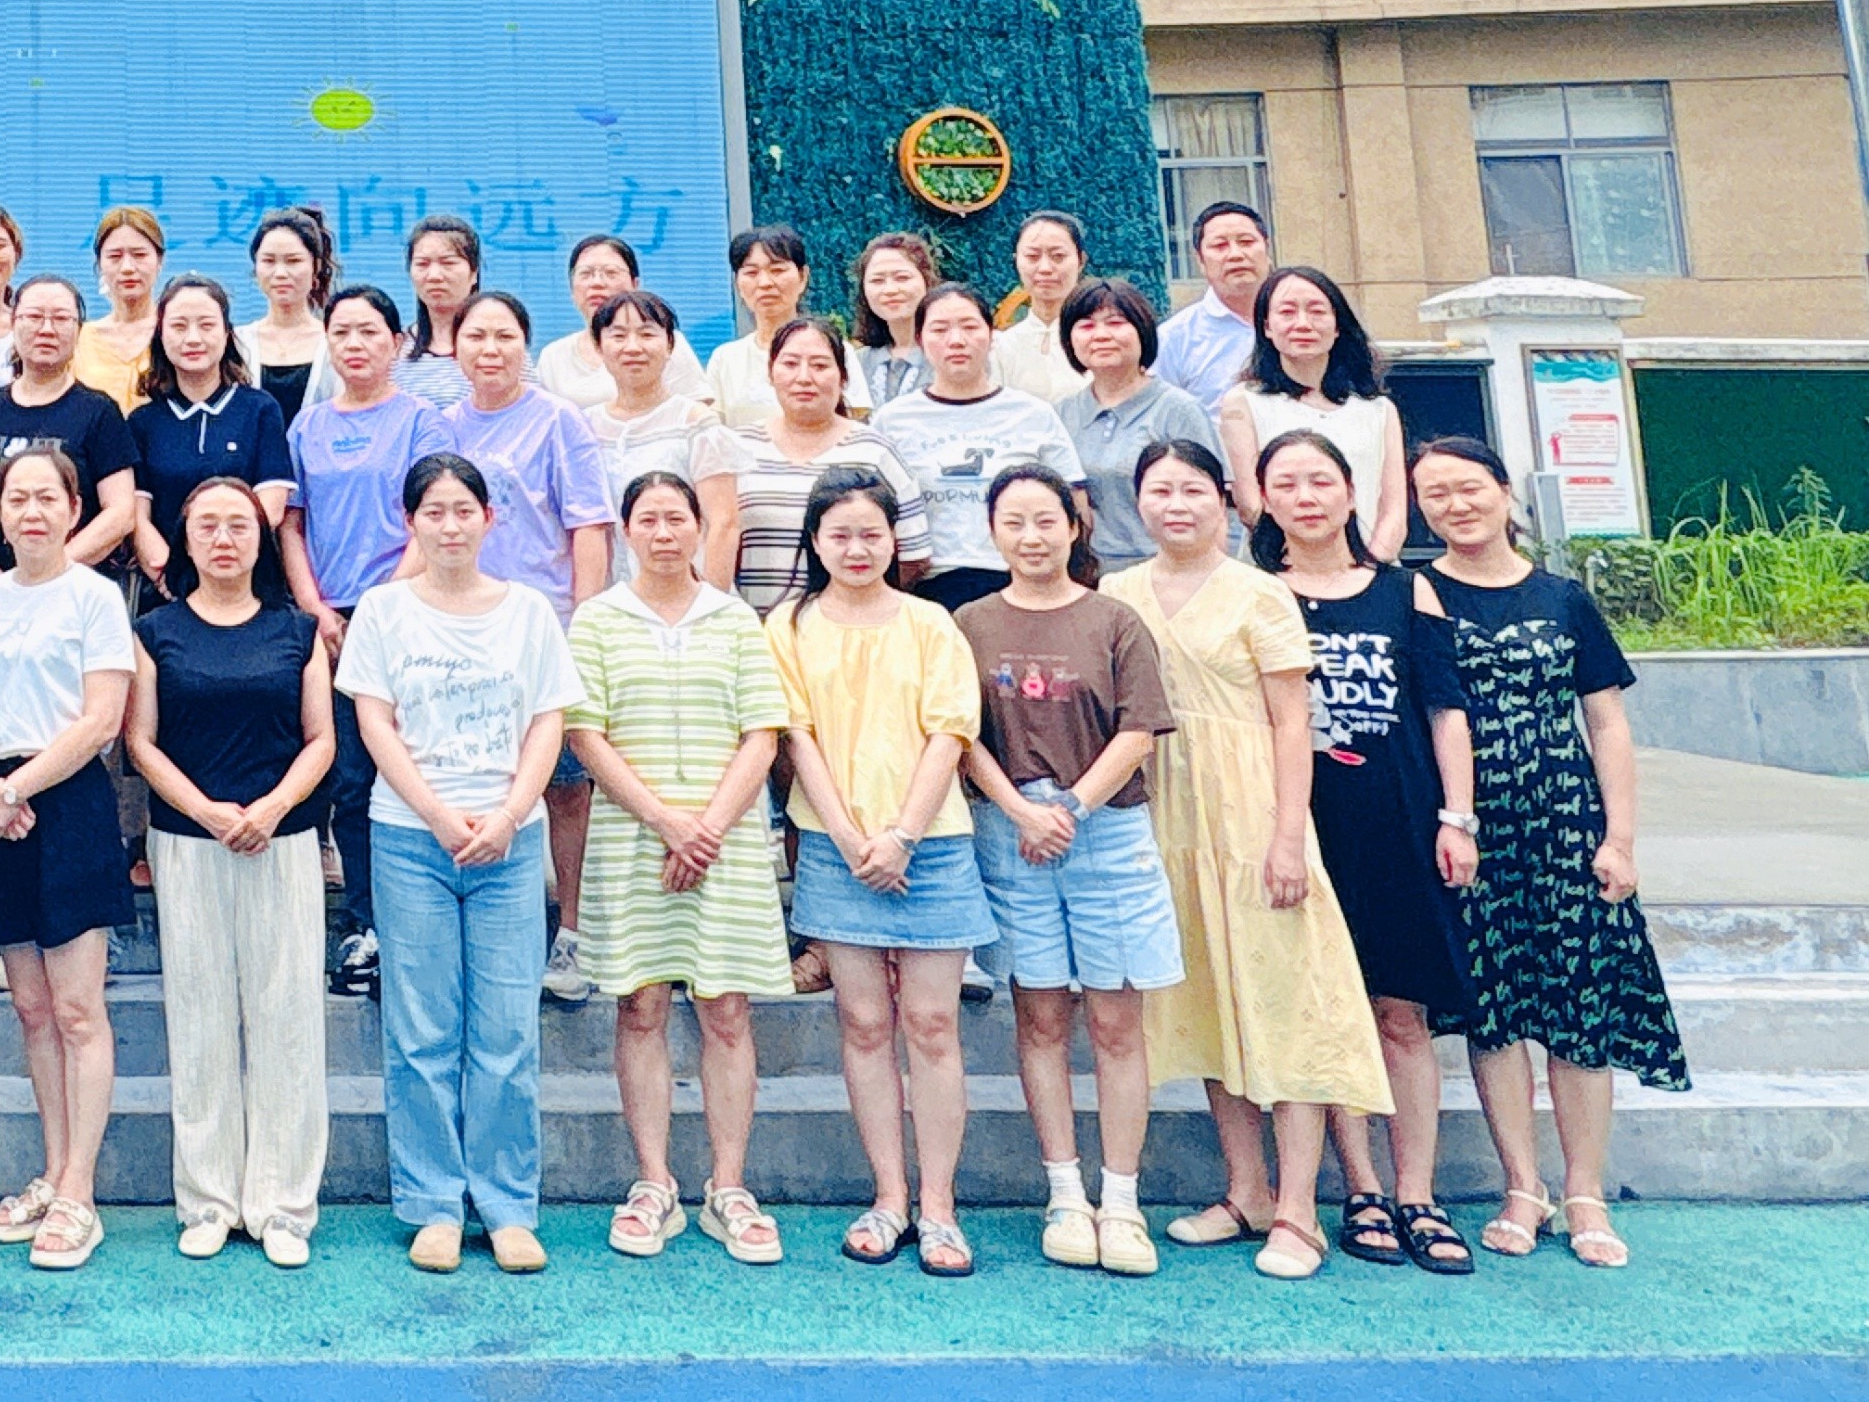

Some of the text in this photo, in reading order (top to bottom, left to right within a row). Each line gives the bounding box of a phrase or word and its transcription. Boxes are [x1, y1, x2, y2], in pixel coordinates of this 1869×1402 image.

[1308, 632, 1392, 654] ON'T
[1312, 652, 1397, 682] EAK
[1308, 676, 1399, 710] UDLY
